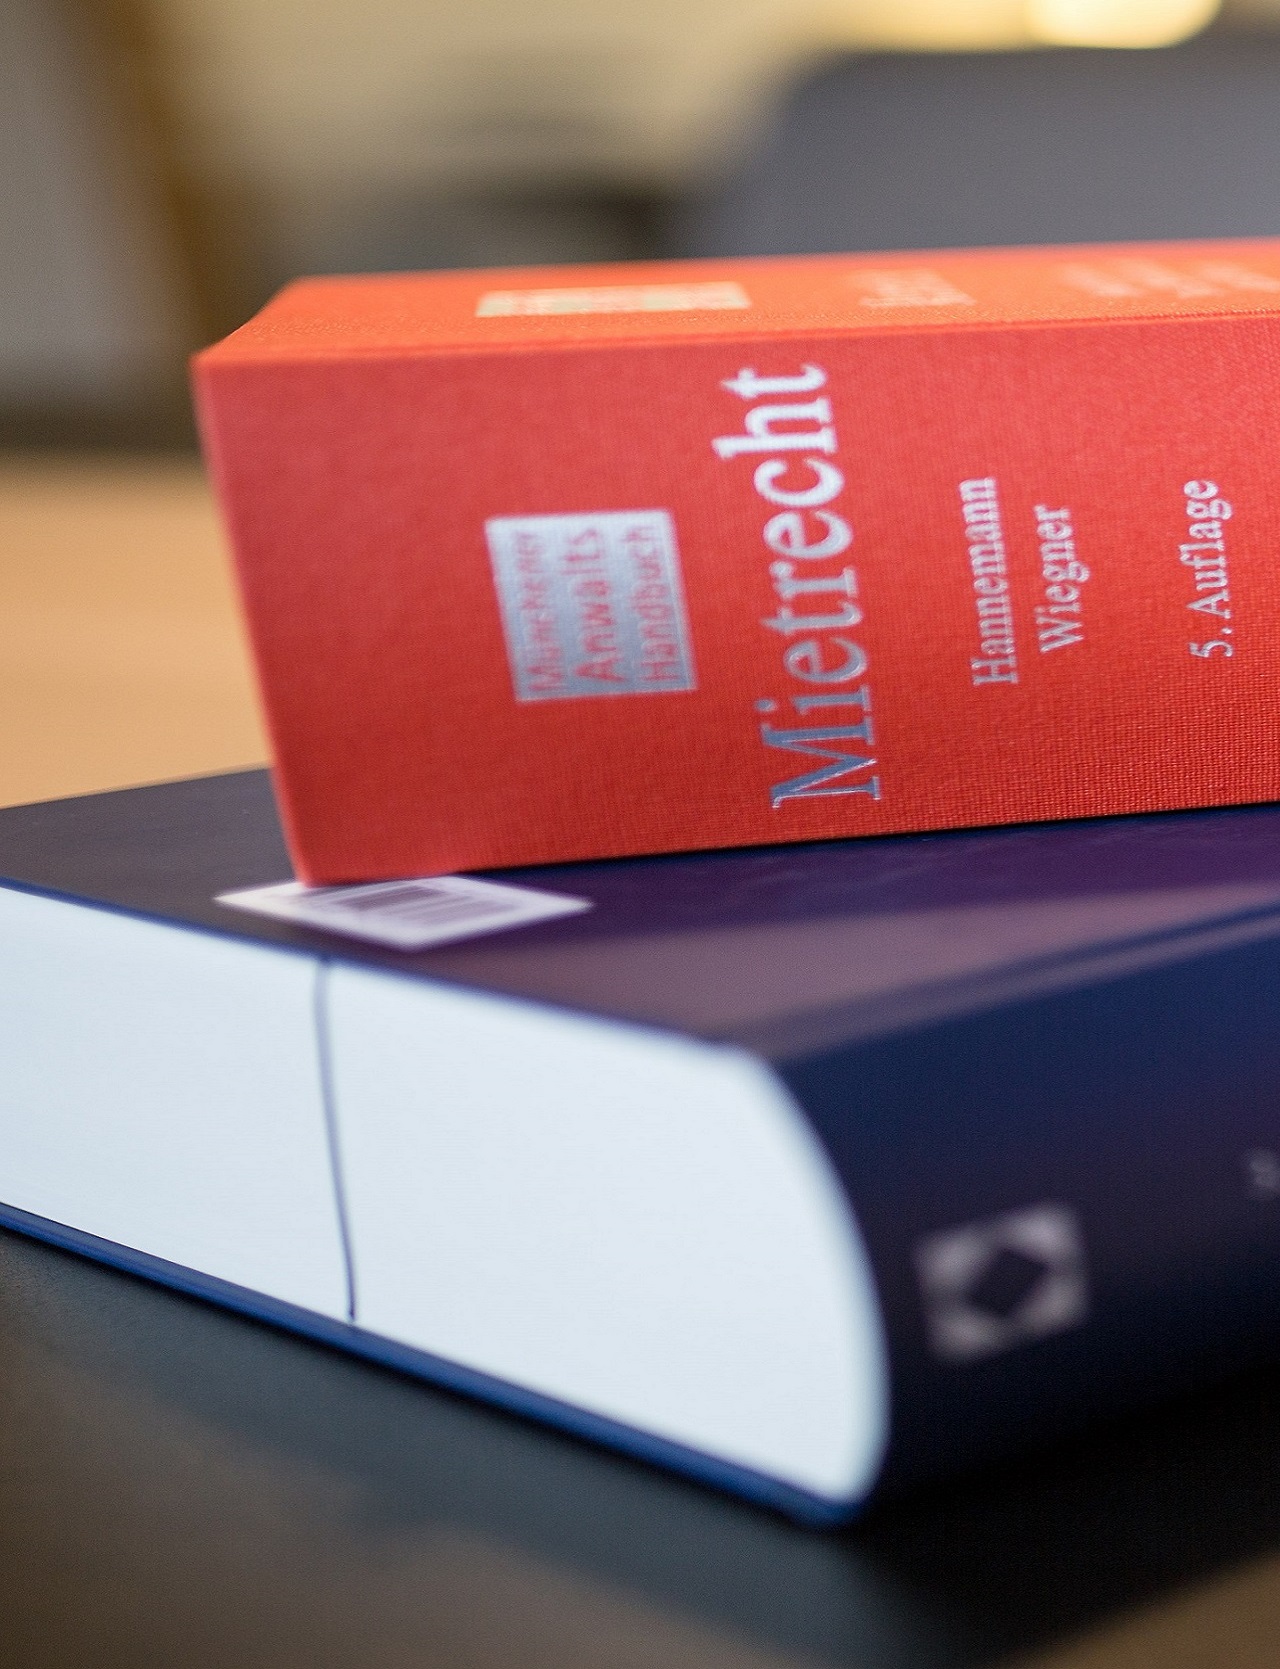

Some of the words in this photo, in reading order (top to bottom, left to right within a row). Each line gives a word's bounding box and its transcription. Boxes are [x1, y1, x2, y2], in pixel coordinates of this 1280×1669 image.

[561, 527, 627, 683] Anwalts
[713, 362, 882, 808] Mietrecht
[959, 476, 1018, 686] Hannemann
[1033, 503, 1091, 654] Wiegner
[1178, 480, 1233, 620] Auflage
[1189, 625, 1234, 658] 5.
